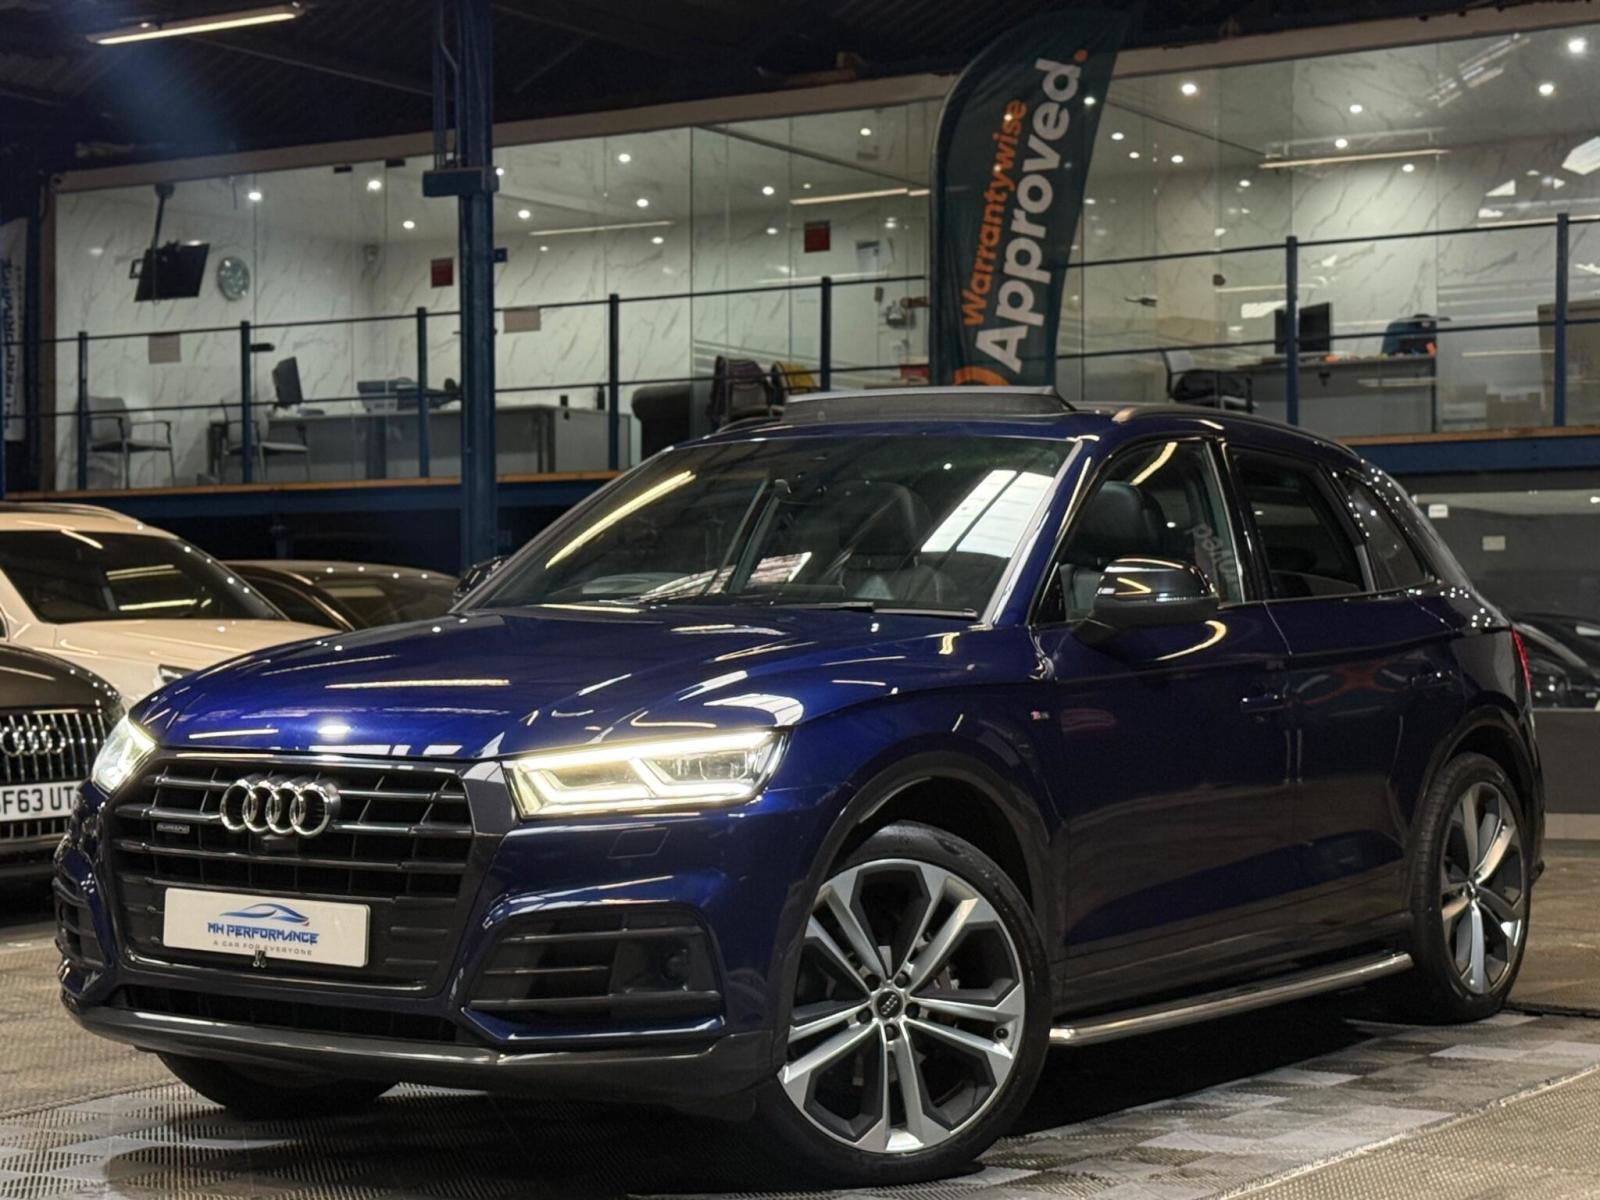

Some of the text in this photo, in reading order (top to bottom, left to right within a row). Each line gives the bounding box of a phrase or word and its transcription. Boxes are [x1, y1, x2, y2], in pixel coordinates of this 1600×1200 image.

[962, 99, 1028, 326] Warrantywise
[0, 785, 79, 814] F63 UT
[208, 922, 320, 945] MH PERFORMANCE
[222, 940, 240, 948] CAR
[243, 943, 260, 951] FOR
[264, 945, 313, 956] EVERYONE
